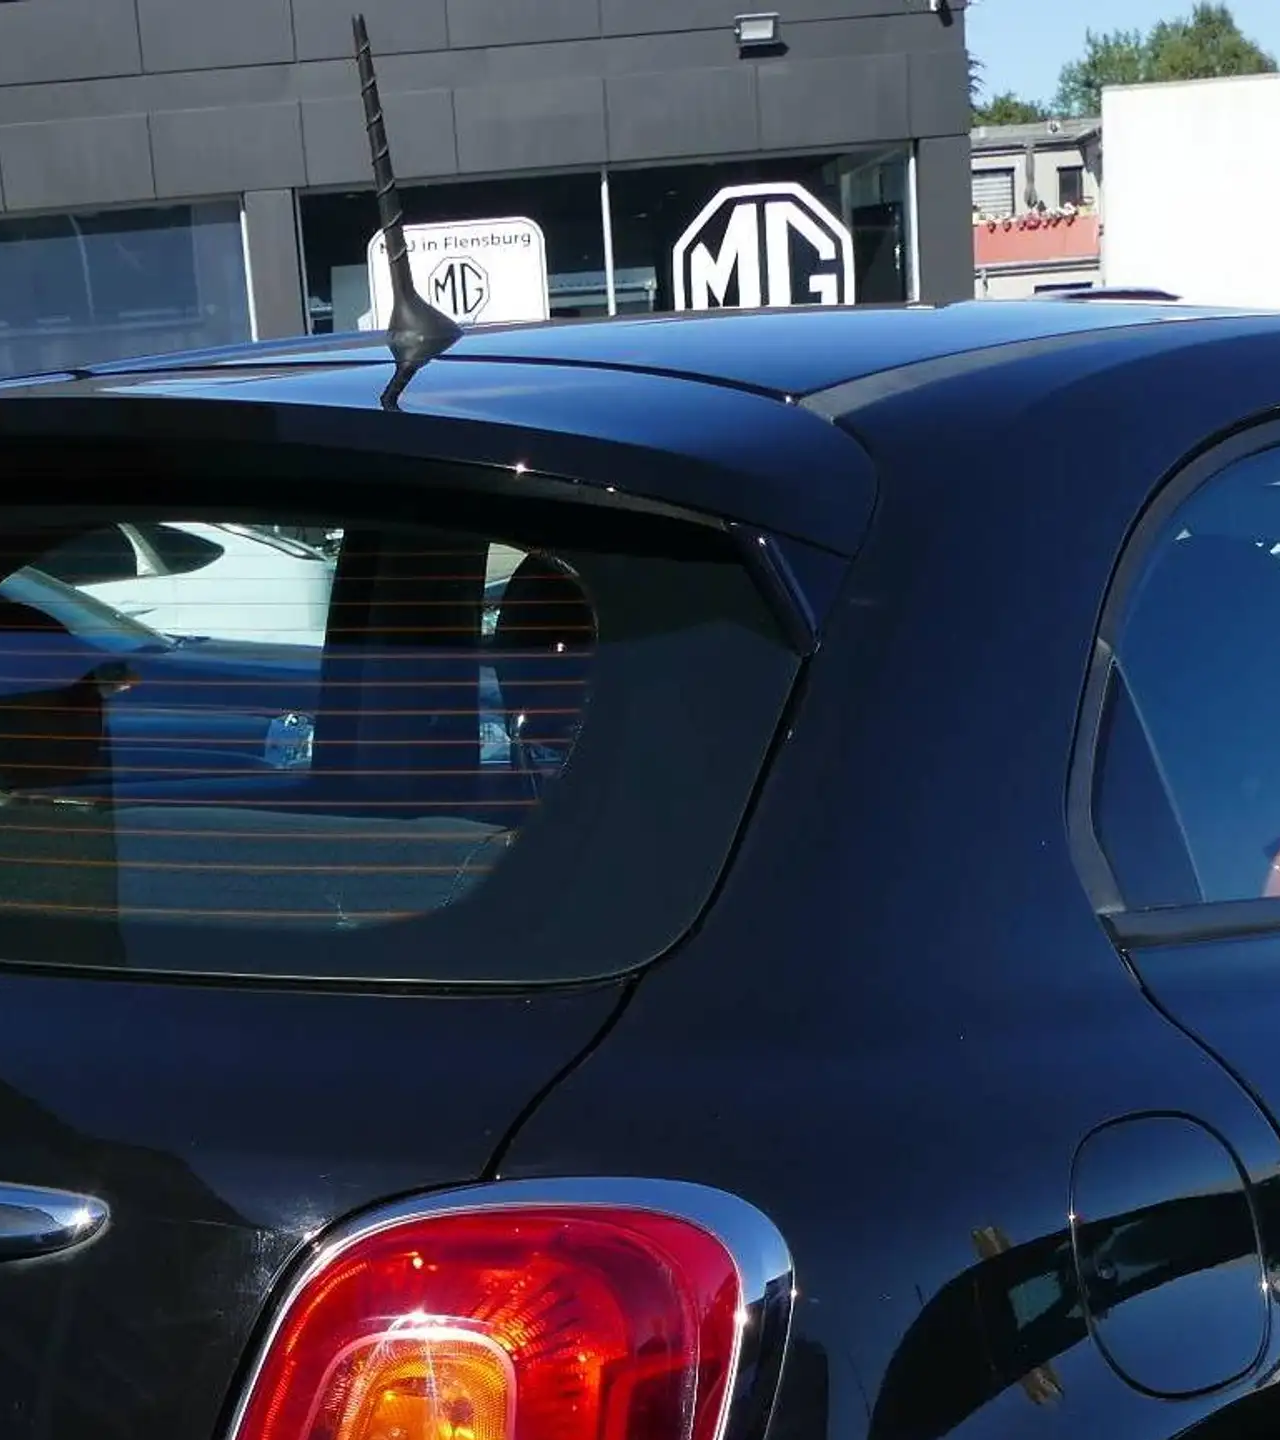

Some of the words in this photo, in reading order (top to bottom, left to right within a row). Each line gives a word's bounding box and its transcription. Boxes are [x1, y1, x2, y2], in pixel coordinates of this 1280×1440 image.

[422, 238, 438, 251] in
[444, 233, 531, 250] Flensburg
[690, 201, 839, 310] MG
[434, 263, 484, 315] MG
